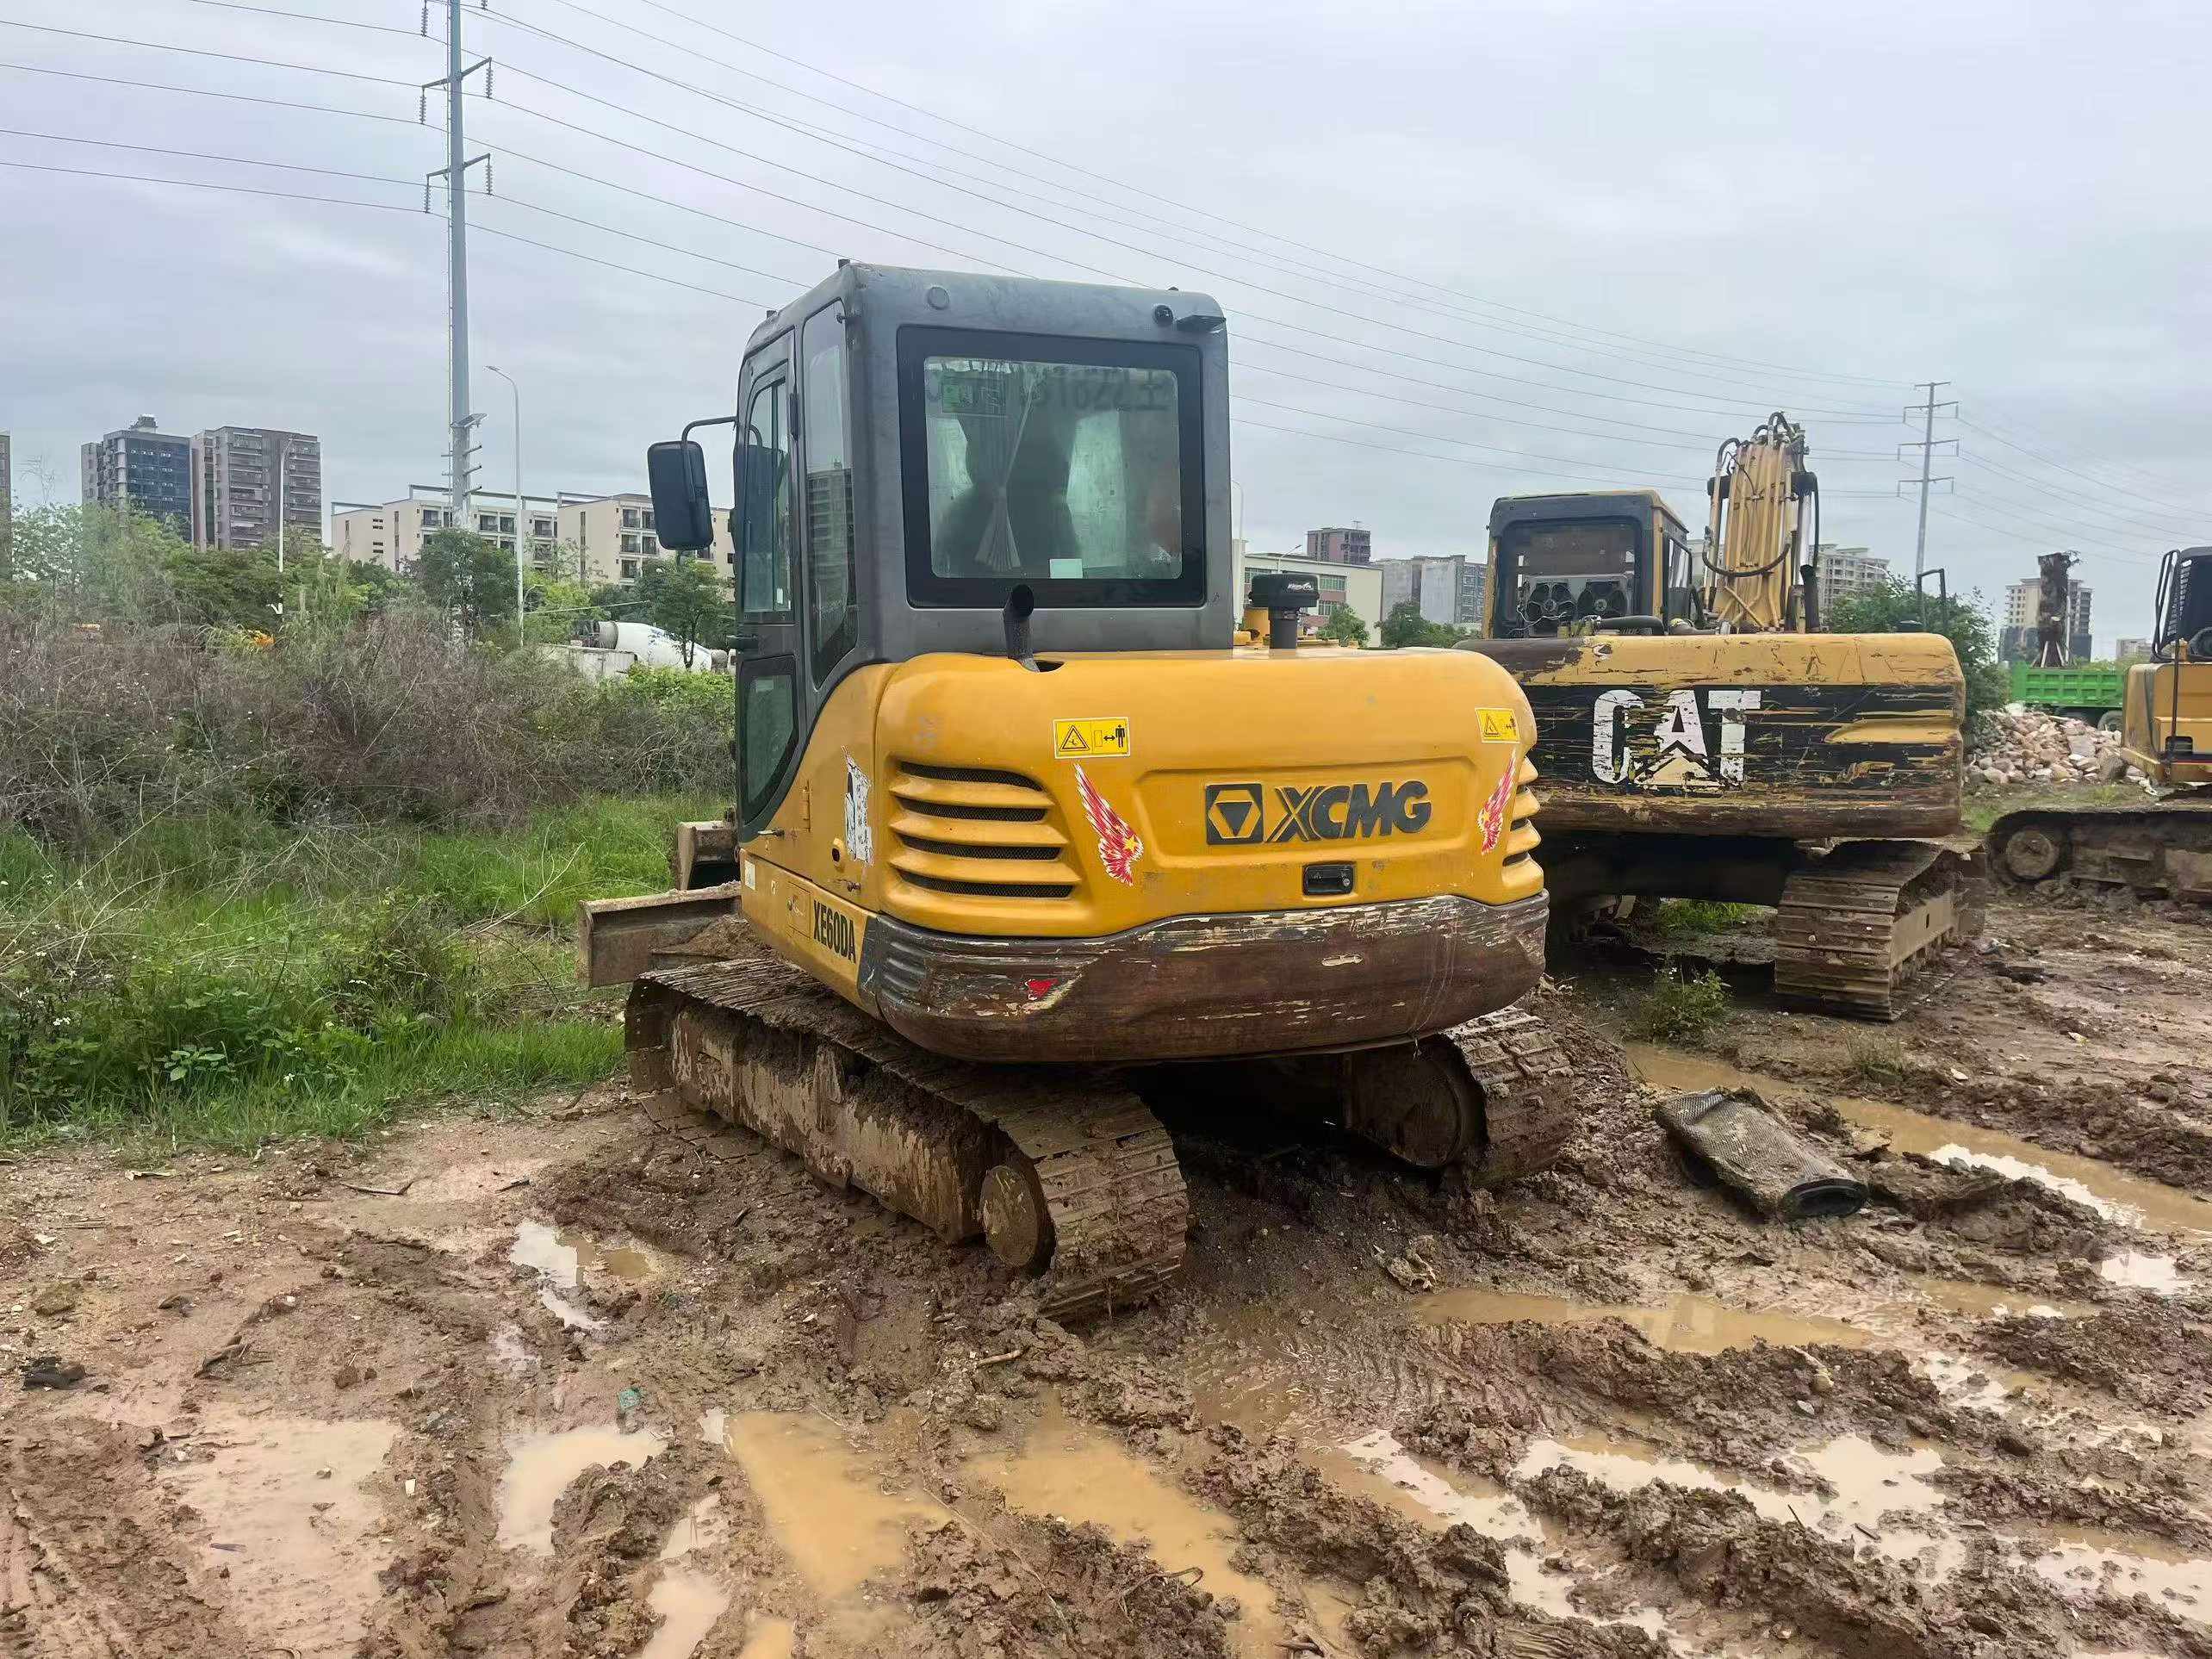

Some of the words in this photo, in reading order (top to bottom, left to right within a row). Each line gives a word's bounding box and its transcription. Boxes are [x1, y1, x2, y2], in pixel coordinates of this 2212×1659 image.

[1593, 689, 1762, 784] CAT
[1267, 780, 1432, 842] XCMG
[813, 899, 857, 964] XE60DA
